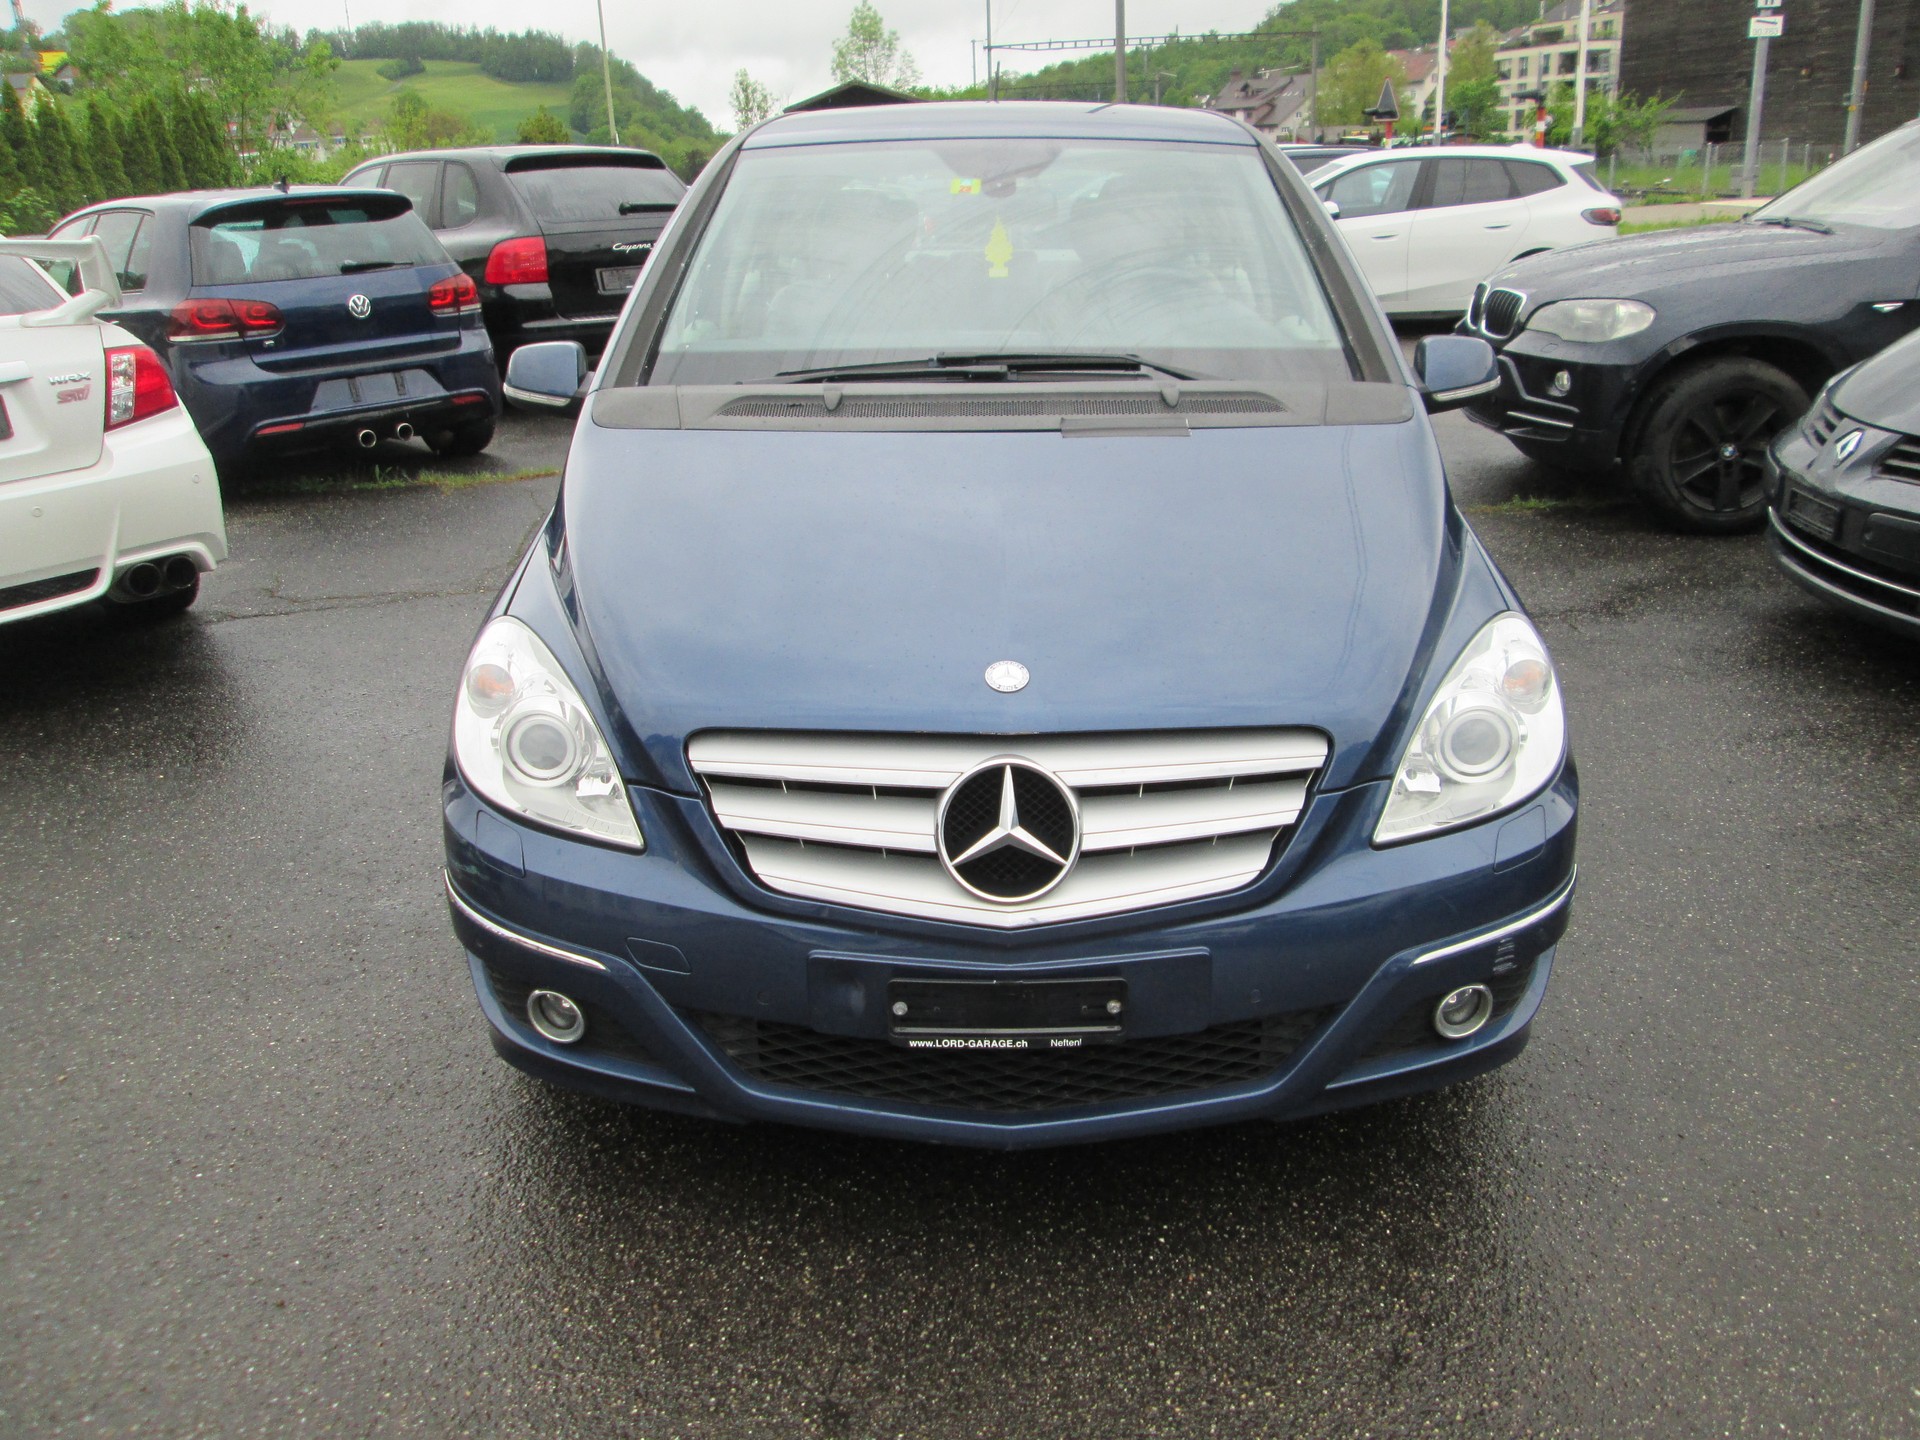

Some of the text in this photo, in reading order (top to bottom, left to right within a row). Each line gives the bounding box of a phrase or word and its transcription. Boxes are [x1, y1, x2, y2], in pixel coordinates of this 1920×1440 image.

[613, 243, 651, 253] Cayenne
[48, 372, 91, 385] WRX
[909, 1039, 1028, 1048] www.LORD-GARAGE.ch
